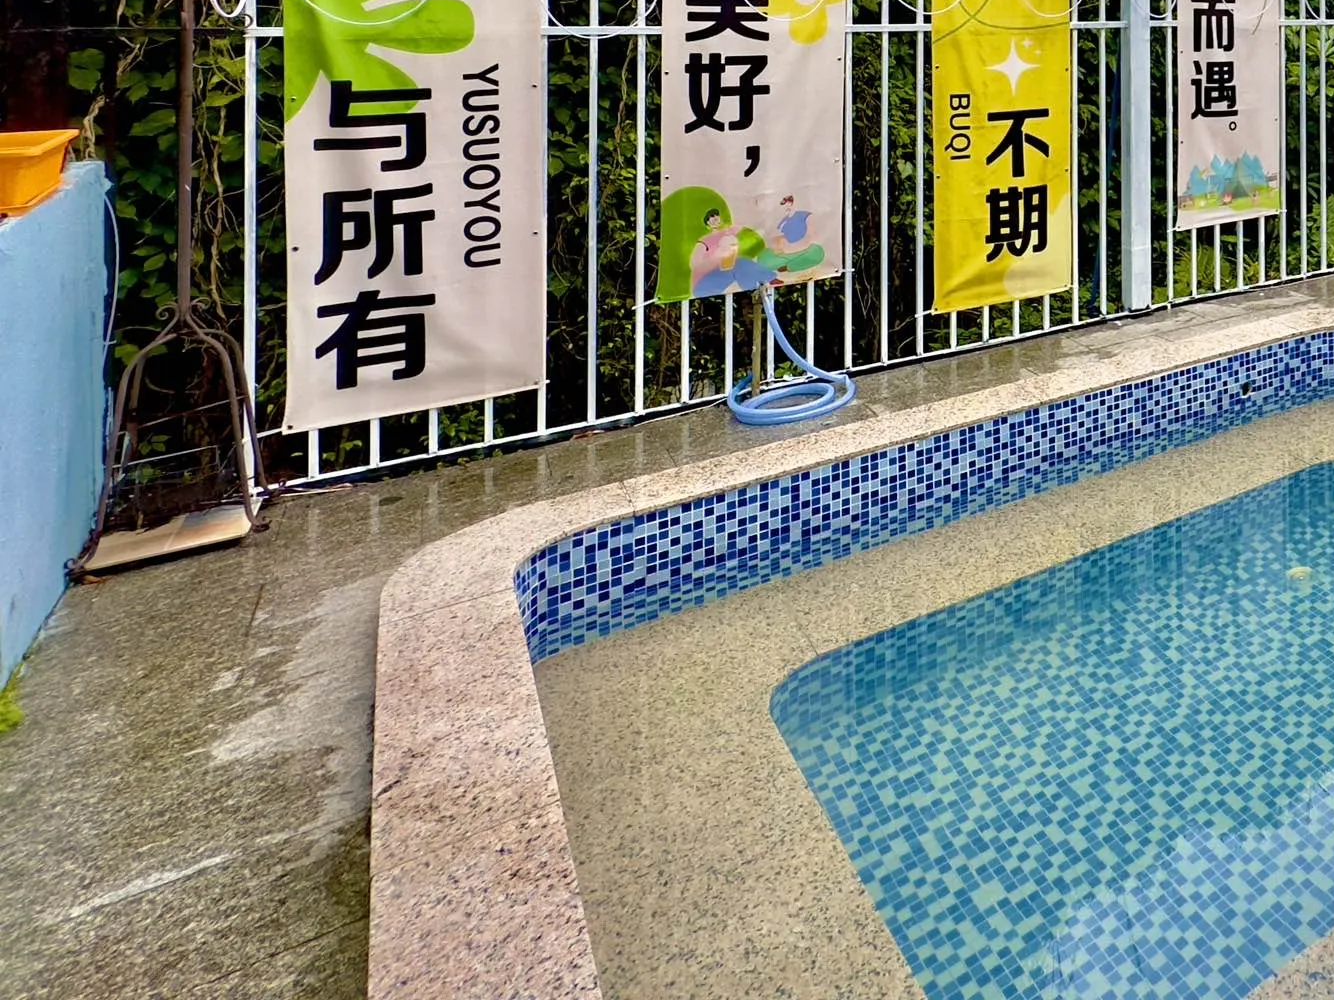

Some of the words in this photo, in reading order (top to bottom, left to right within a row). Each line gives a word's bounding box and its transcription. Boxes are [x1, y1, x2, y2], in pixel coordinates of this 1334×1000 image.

[462, 63, 502, 269] YUSUOYOU
[944, 92, 971, 160] BUQI
[985, 108, 1050, 262] 不期
[313, 80, 436, 390] 与所有
